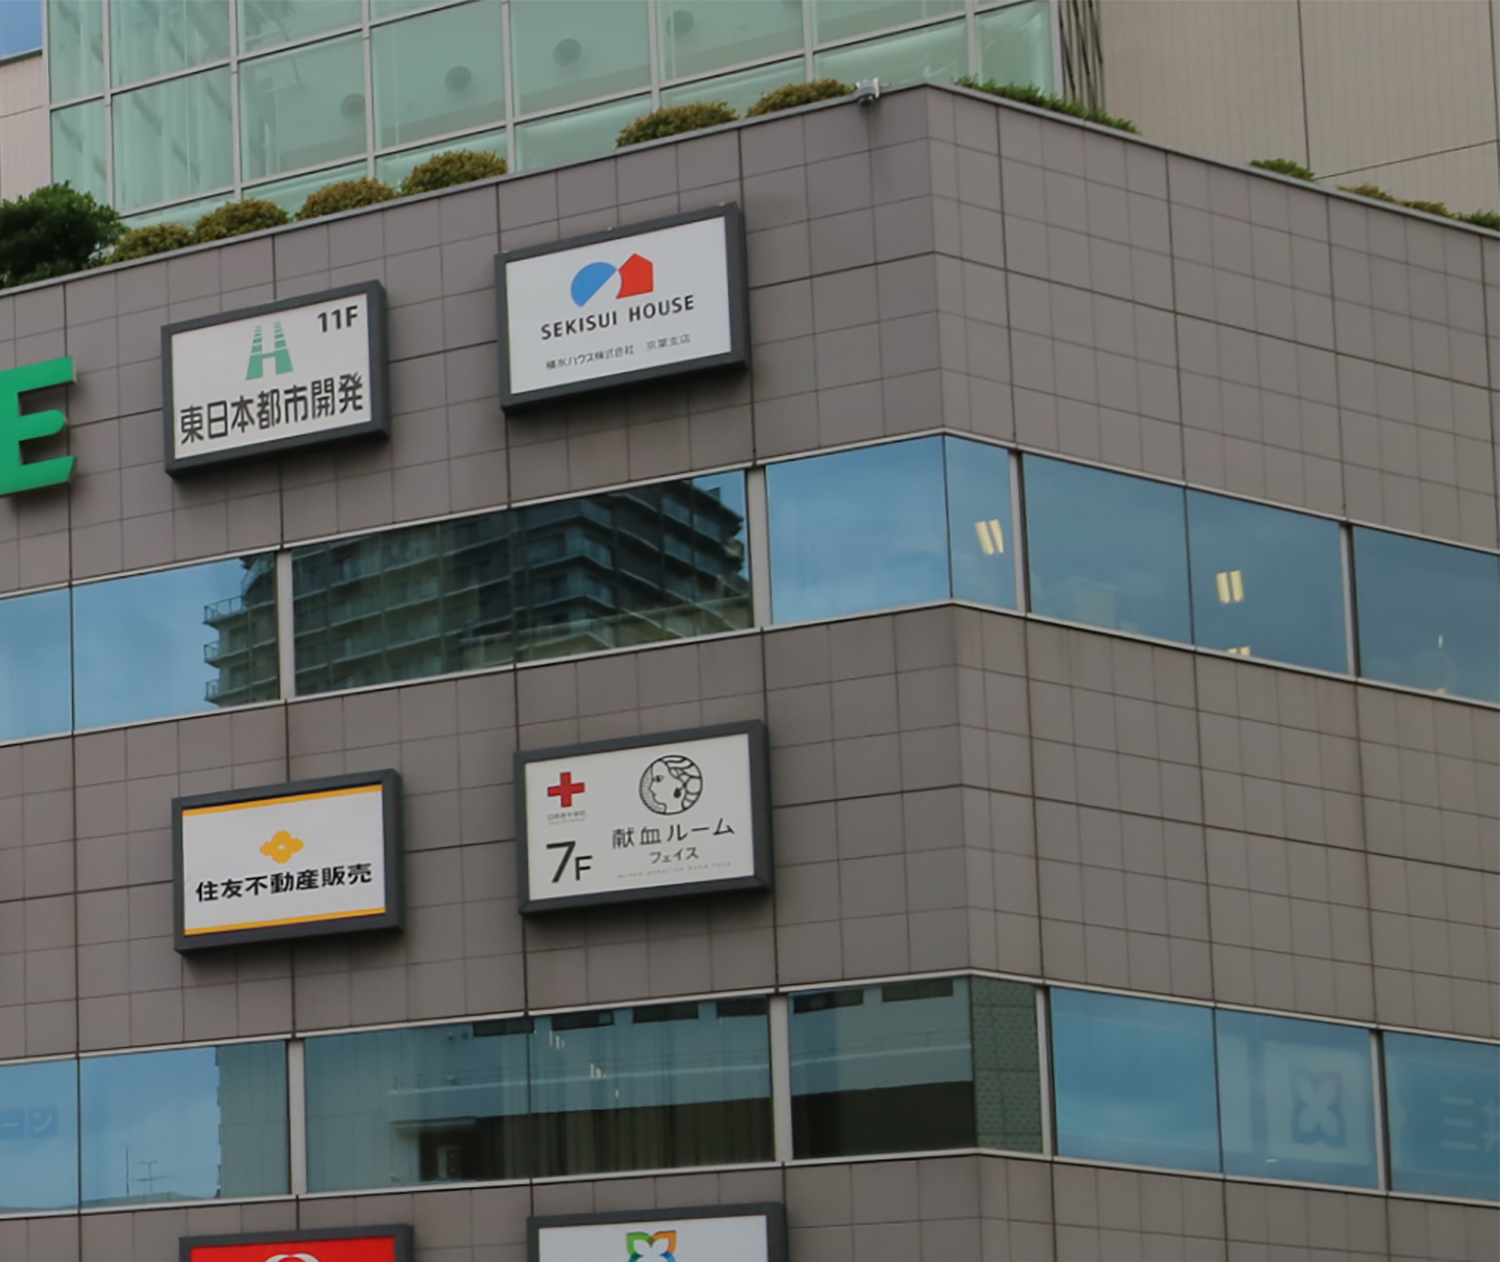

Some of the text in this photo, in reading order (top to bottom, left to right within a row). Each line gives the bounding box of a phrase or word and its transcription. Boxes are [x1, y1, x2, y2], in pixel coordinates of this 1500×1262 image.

[317, 305, 358, 333] 11F
[540, 294, 694, 340] SEKISUI HOUSE
[180, 372, 363, 445] 東日本都市開発
[612, 817, 735, 850] 献血ルーム
[546, 840, 593, 883] 7F
[649, 847, 699, 865] フェイス
[195, 863, 373, 903] 住友不動産販売
